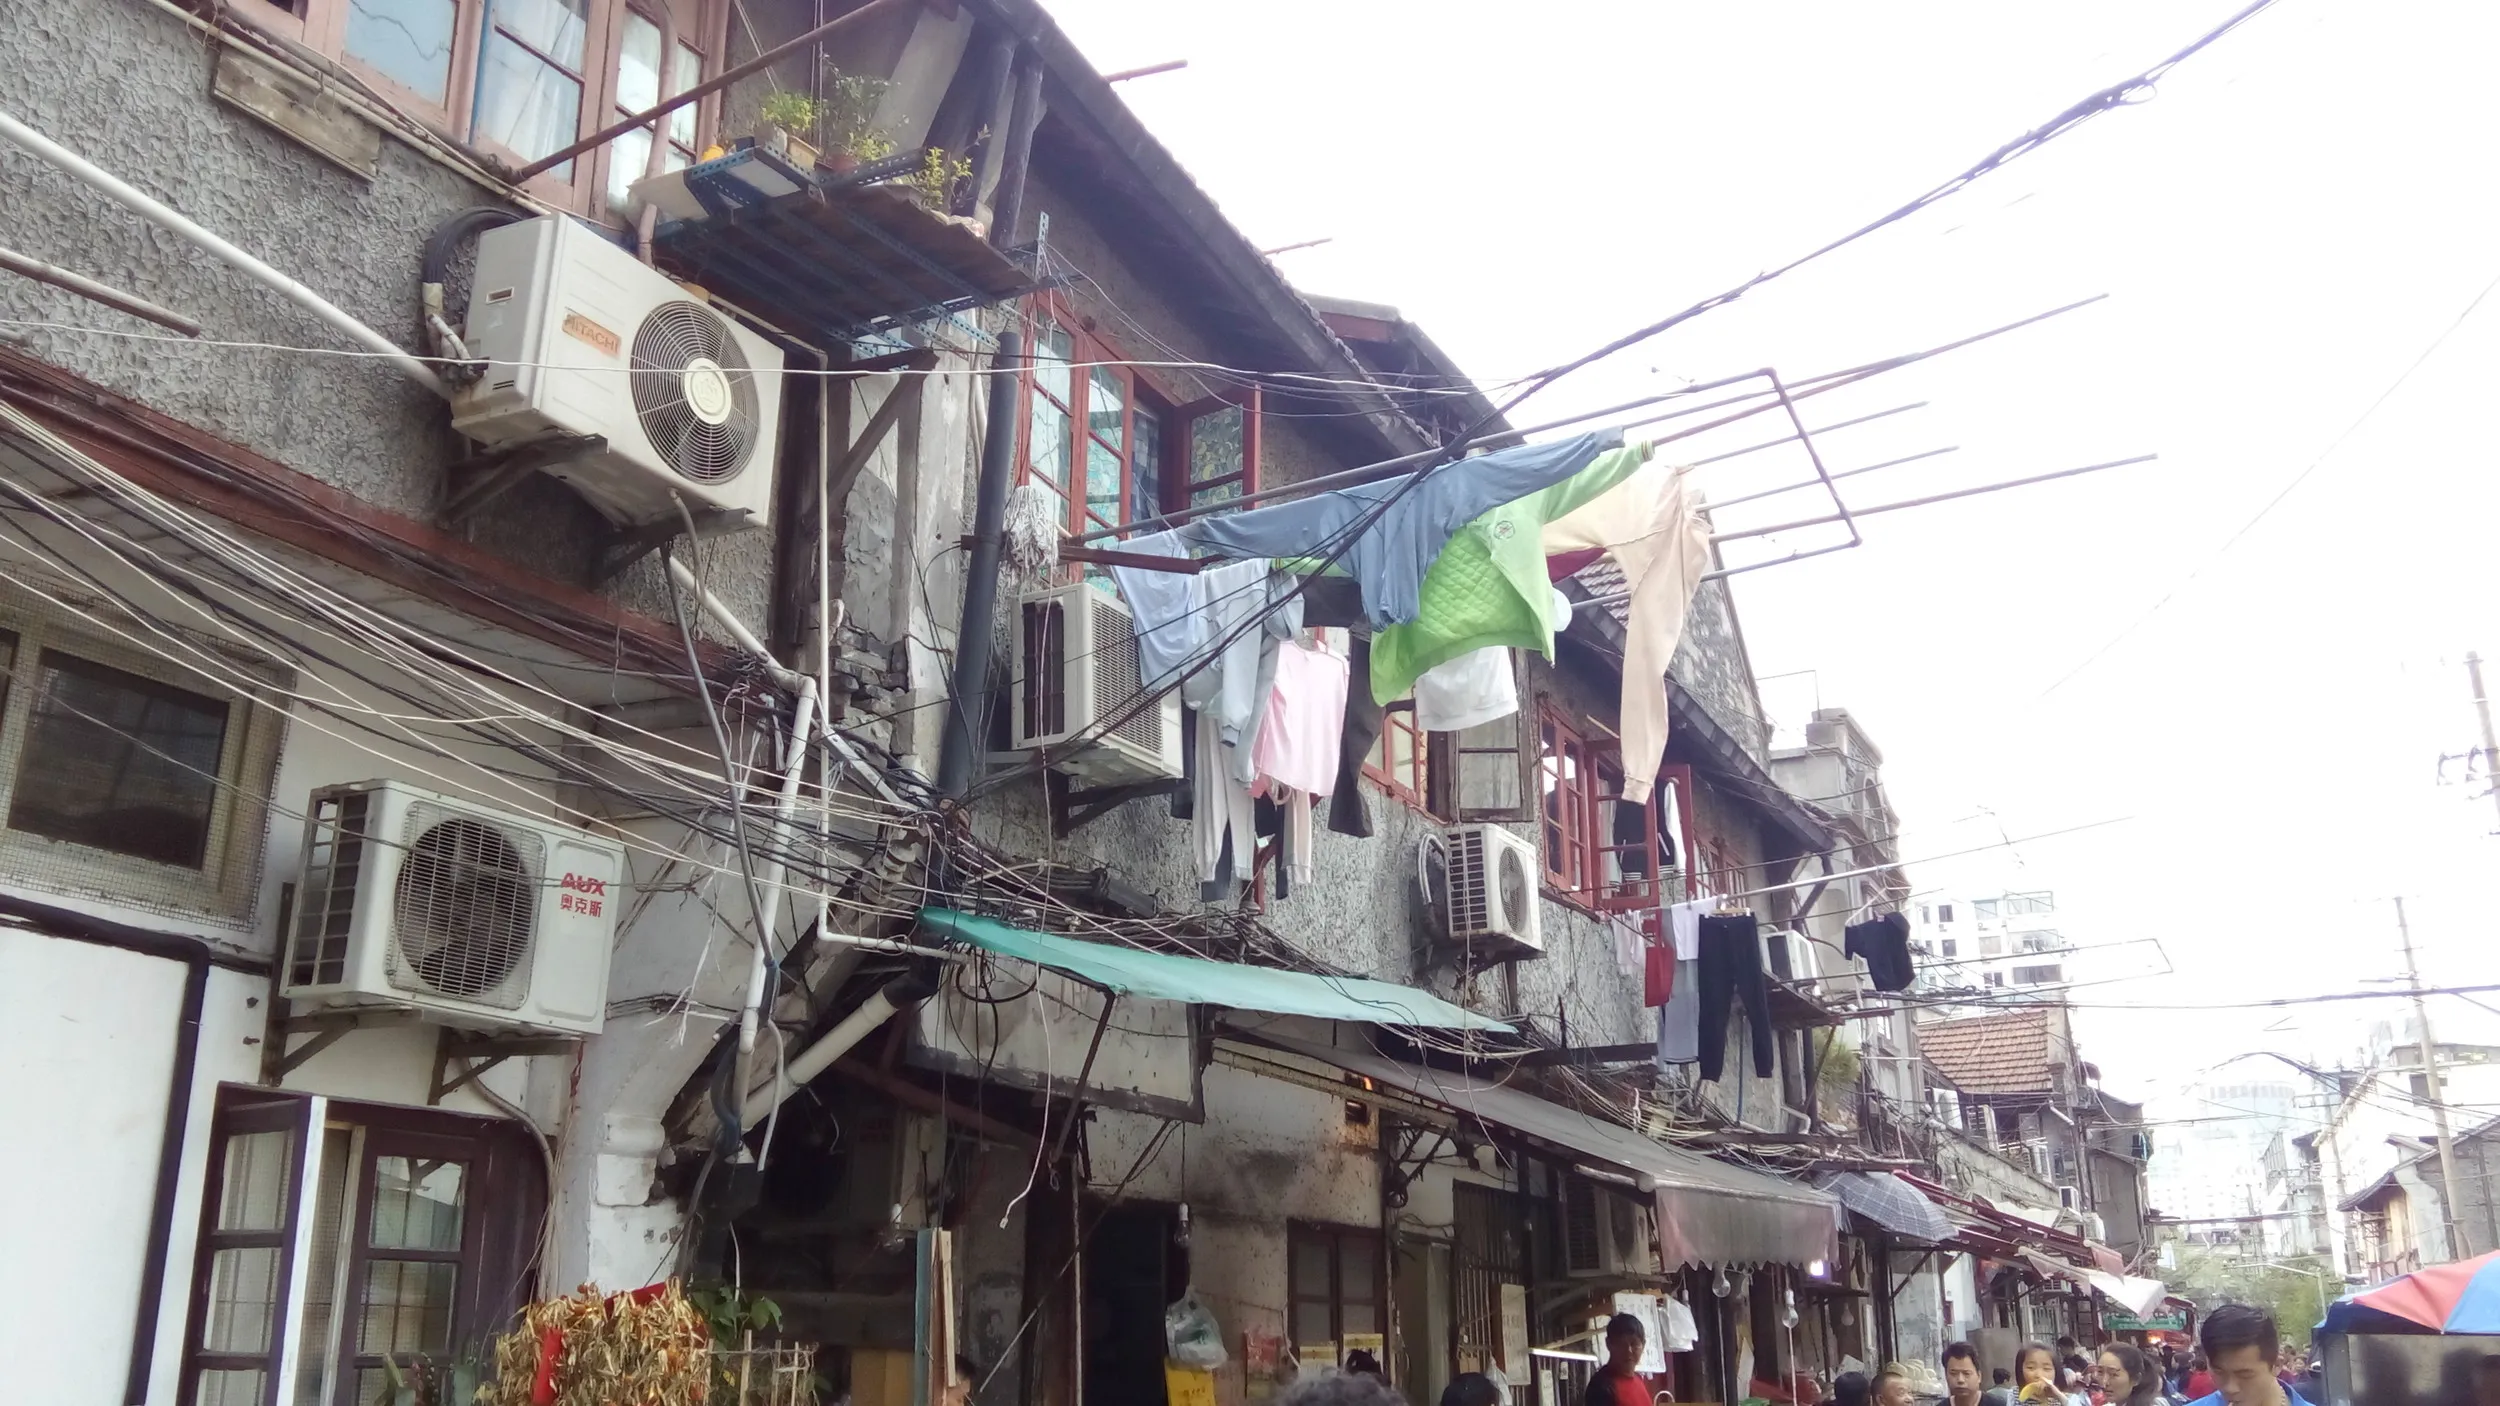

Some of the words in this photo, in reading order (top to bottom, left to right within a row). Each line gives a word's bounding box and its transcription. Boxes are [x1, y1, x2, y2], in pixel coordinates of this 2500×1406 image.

[564, 314, 619, 354] HITACHI
[560, 872, 607, 897] AUX
[560, 893, 603, 918] 奥克斯
